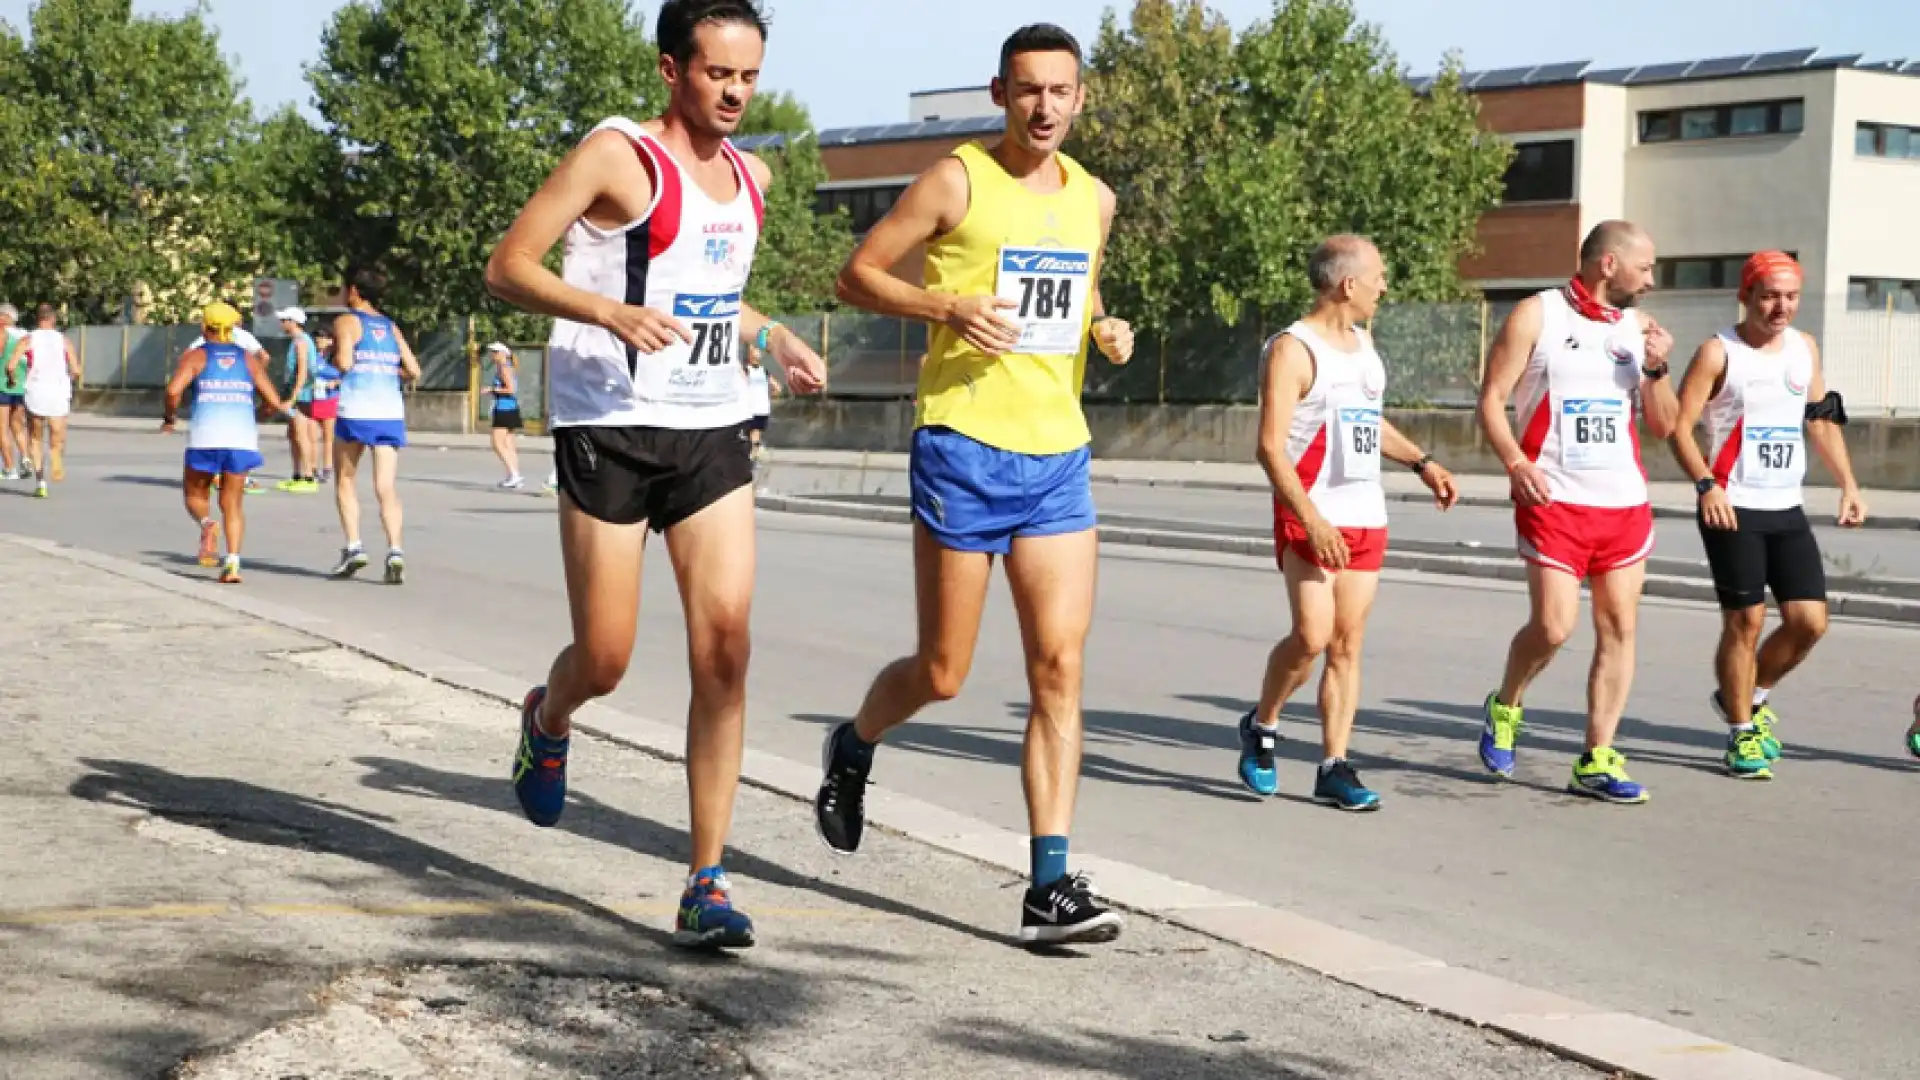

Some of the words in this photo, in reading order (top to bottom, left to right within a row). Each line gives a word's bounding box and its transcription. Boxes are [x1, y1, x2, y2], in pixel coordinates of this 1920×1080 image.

[1018, 277, 1072, 319] 784
[687, 321, 733, 366] 782
[1576, 416, 1616, 443] 635
[1758, 442, 1794, 469] 637
